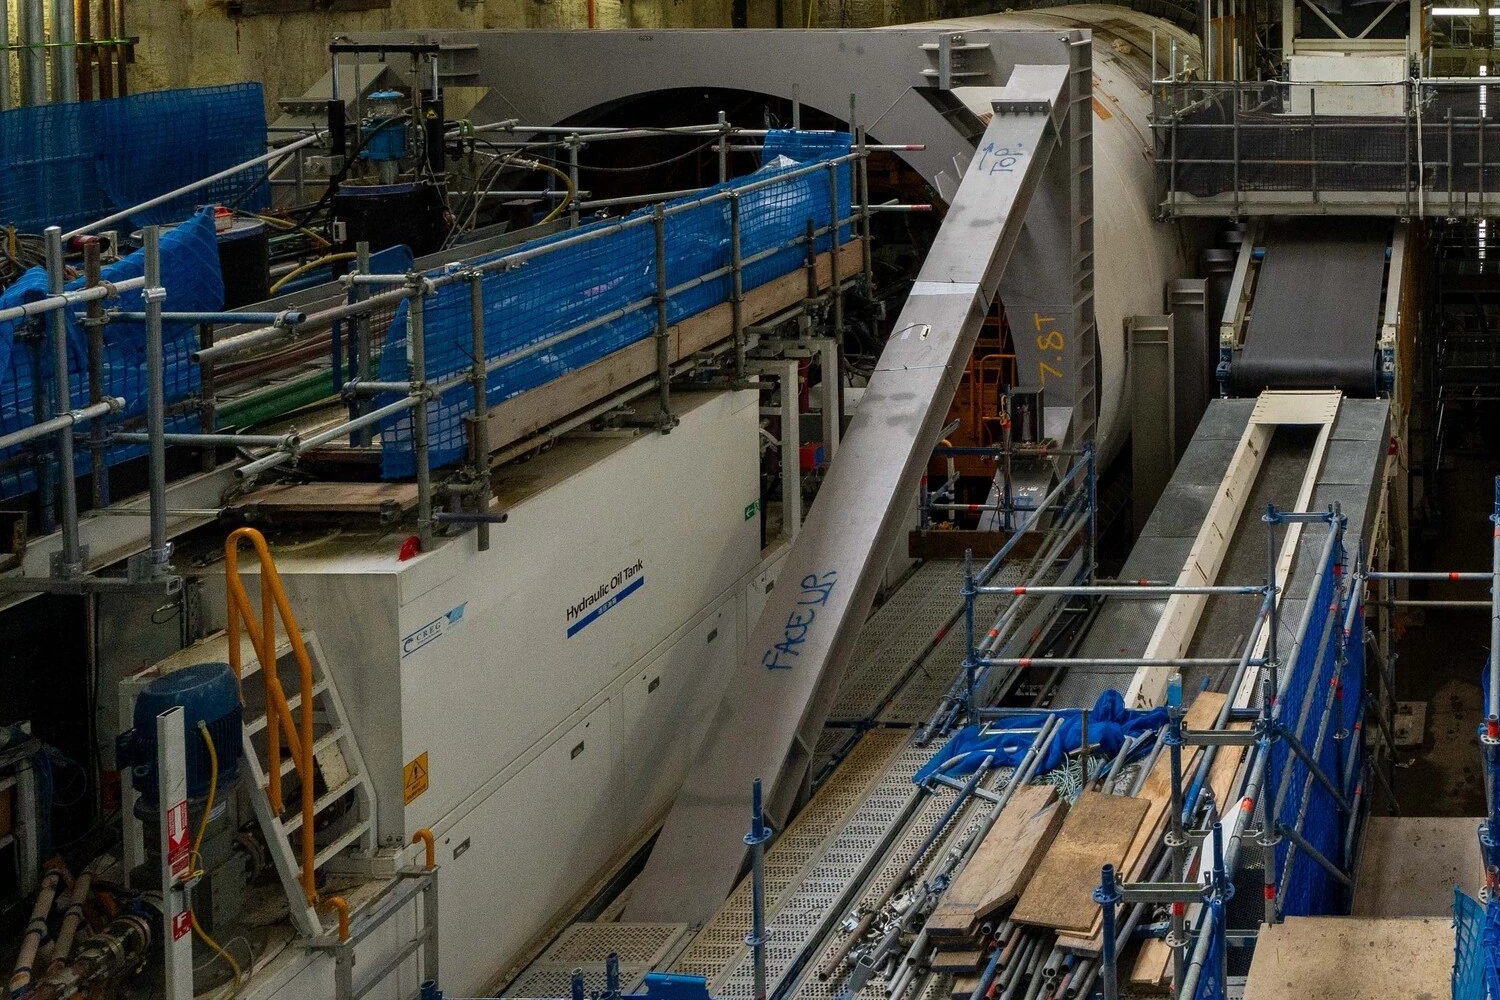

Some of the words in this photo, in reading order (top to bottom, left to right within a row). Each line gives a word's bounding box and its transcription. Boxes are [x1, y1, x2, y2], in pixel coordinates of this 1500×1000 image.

[1034, 312, 1064, 387] 7.8T
[566, 583, 610, 621] Hydraulic
[610, 571, 623, 589] Oil
[618, 558, 644, 580] Tank
[416, 622, 441, 641] CREG
[762, 608, 815, 670] FACE
